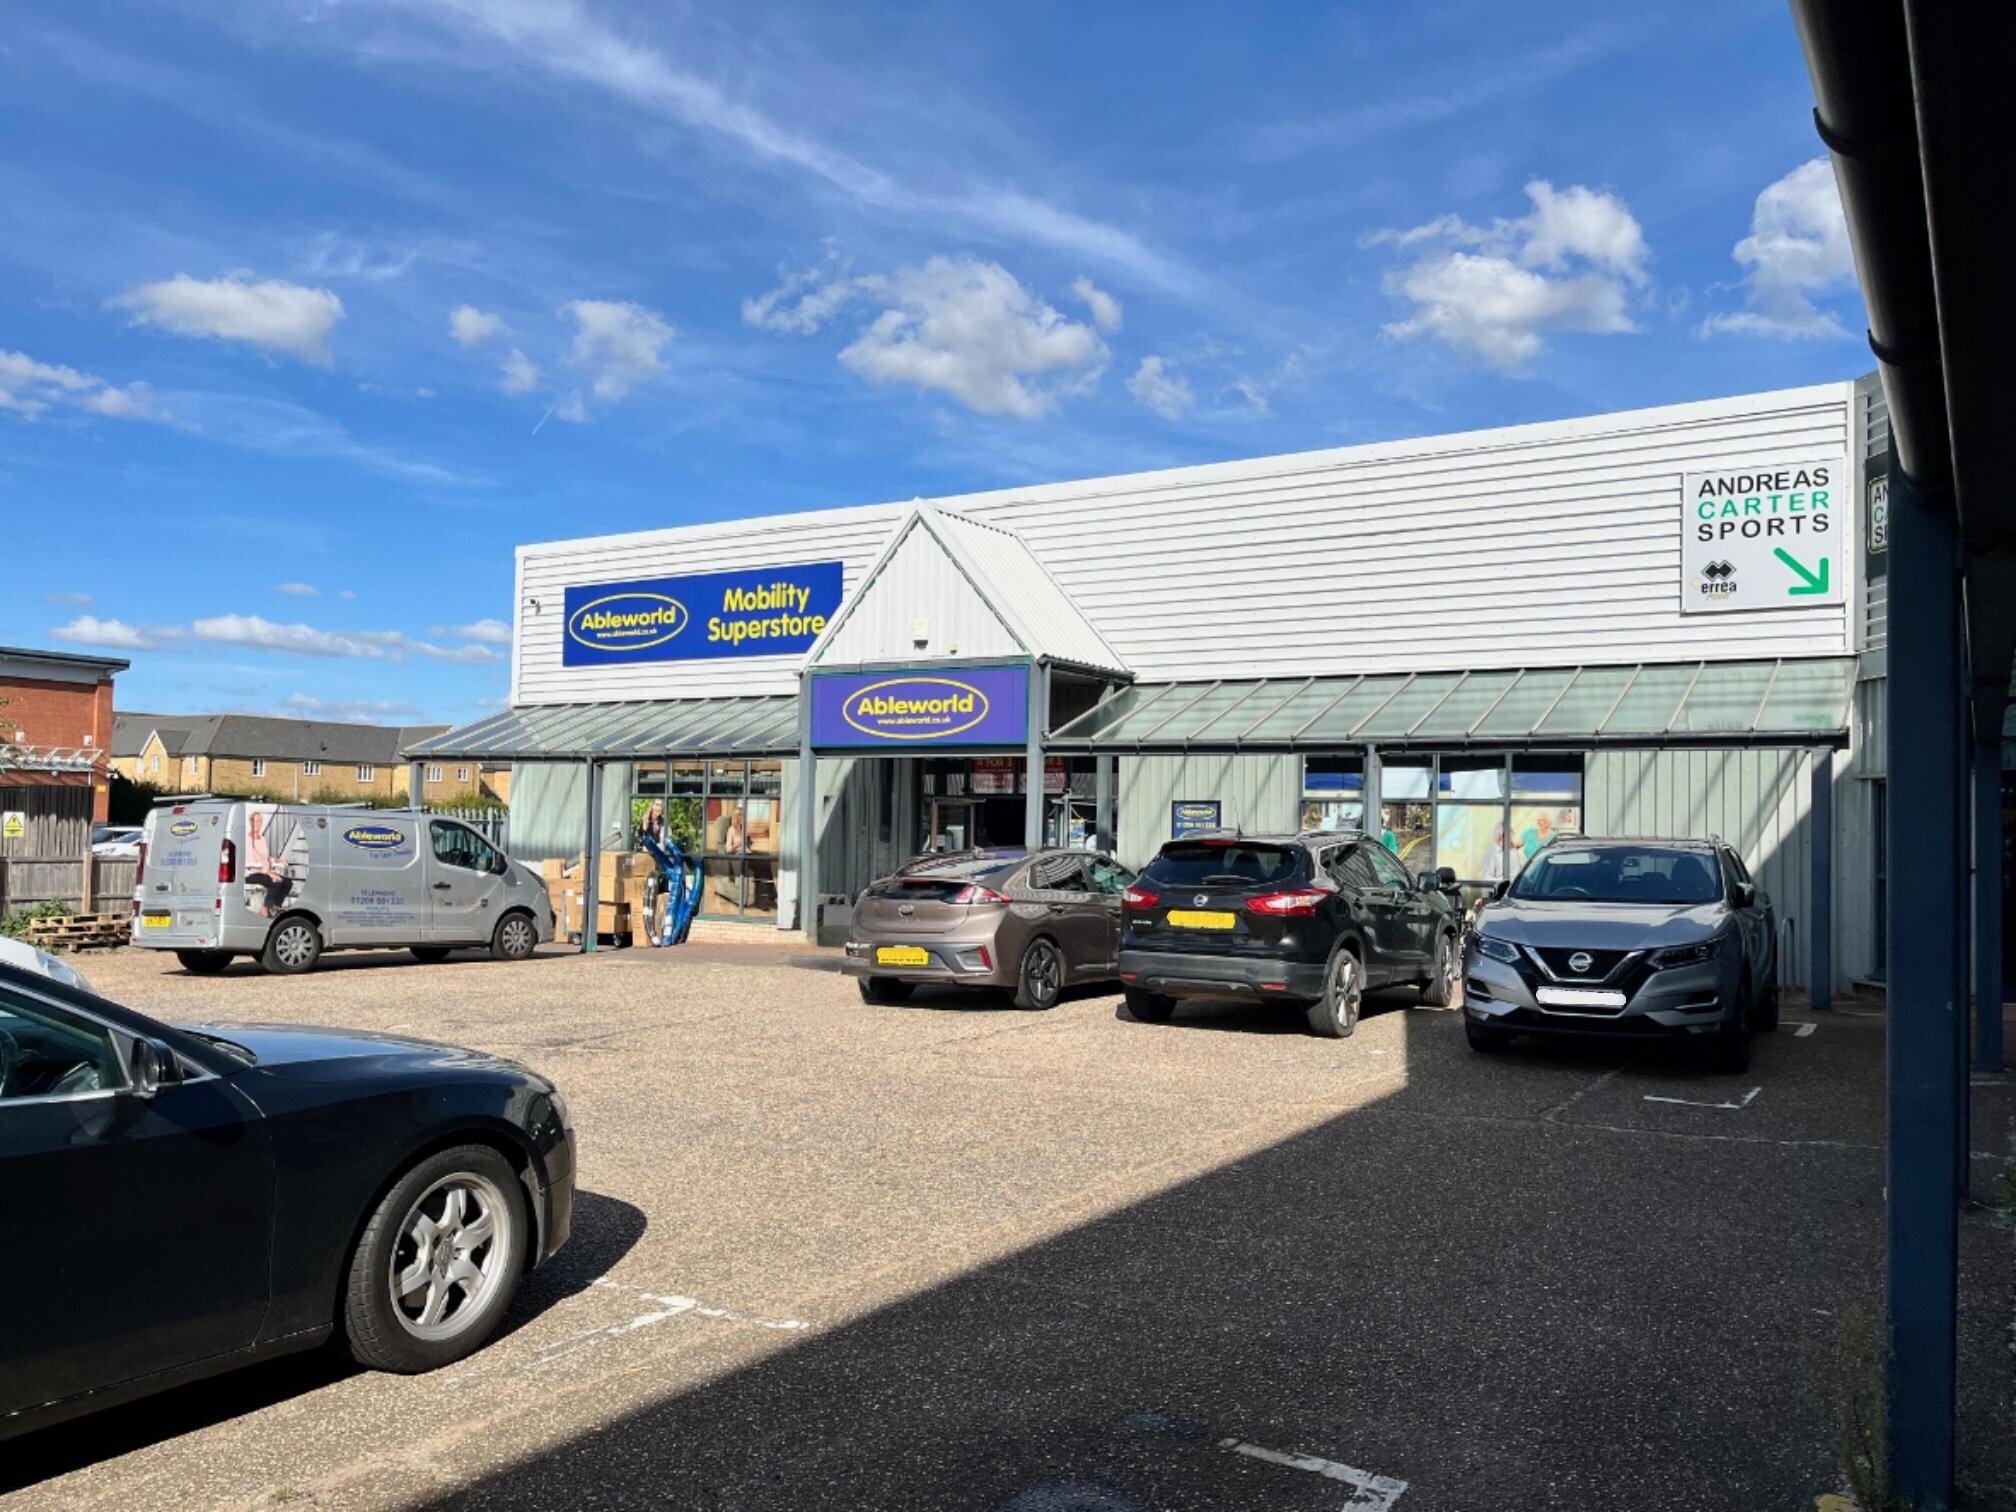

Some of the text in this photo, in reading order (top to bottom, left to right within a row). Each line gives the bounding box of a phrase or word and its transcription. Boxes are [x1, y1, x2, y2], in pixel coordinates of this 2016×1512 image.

[1698, 468, 1829, 498] ANDREAS
[1698, 491, 1829, 520] CARTER
[1698, 513, 1829, 542] SPORTS
[723, 582, 810, 614] Mobility
[581, 605, 676, 630] Ableworld
[707, 612, 826, 646] Superstore
[857, 693, 974, 716] Ableworld
